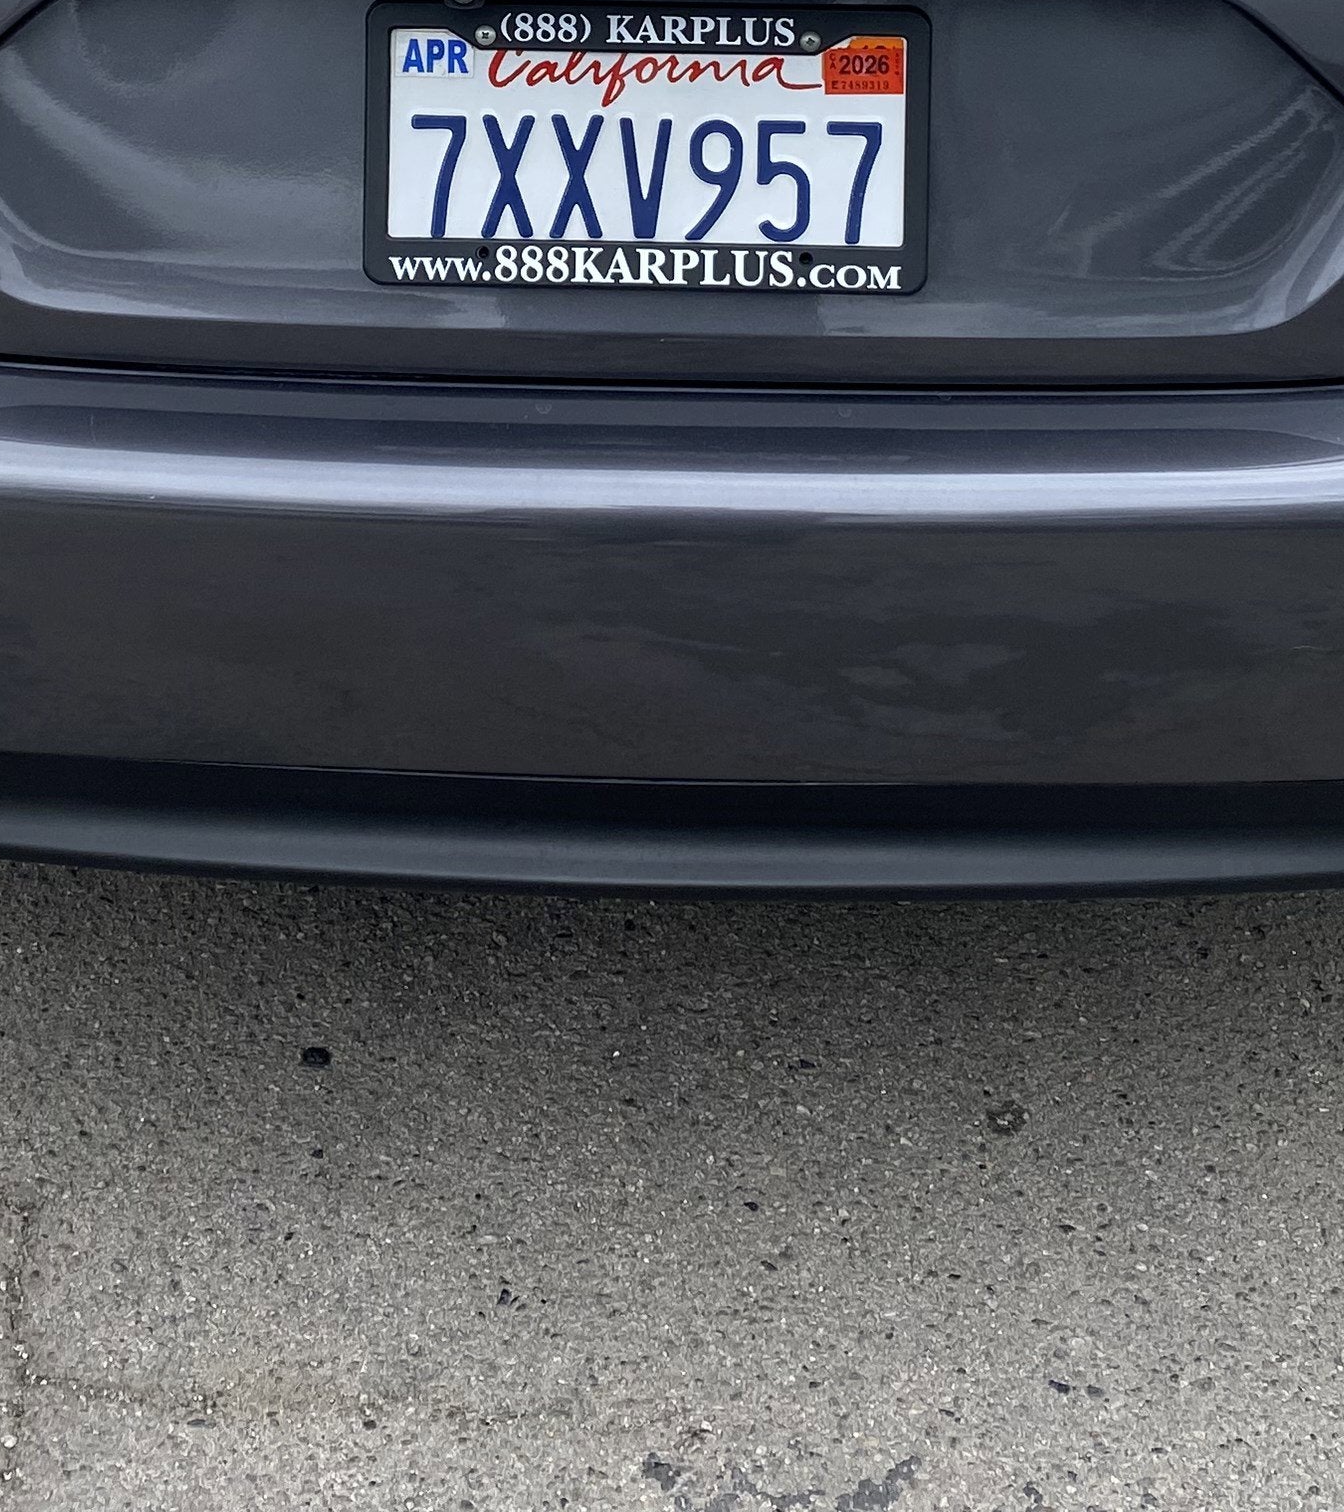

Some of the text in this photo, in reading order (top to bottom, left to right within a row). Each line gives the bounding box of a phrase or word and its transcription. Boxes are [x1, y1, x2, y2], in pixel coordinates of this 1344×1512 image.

[500, 14, 796, 47] (888) KARPLUS
[401, 38, 469, 75] APR
[838, 54, 890, 75] 2026
[488, 49, 823, 107] California
[411, 114, 883, 245] 7XXV957
